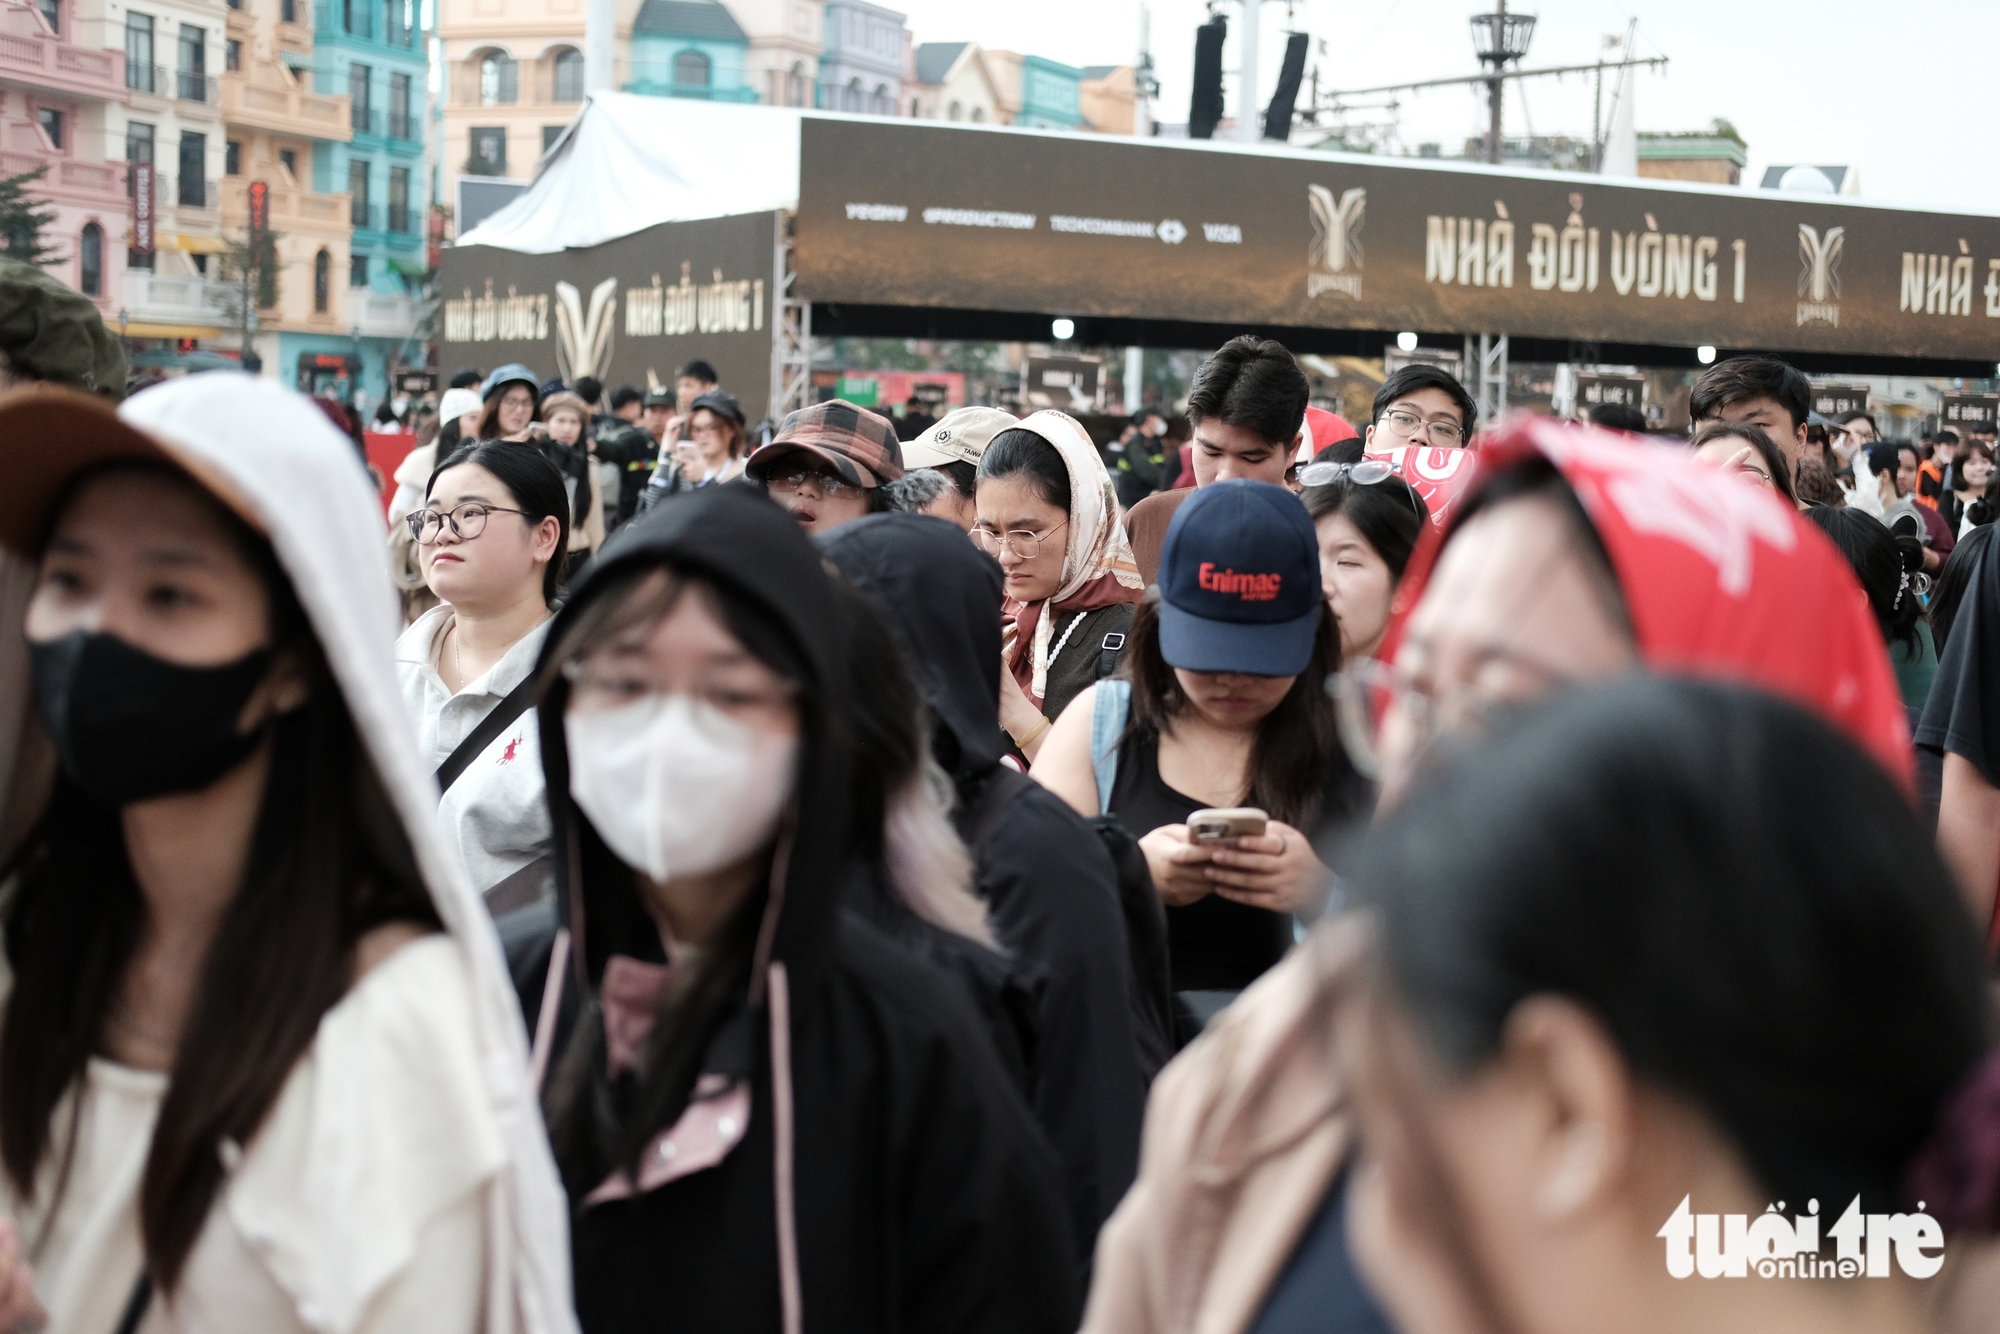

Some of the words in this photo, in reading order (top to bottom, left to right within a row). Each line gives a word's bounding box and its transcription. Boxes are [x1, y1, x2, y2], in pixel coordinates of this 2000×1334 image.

[1049, 214, 1156, 239] TECHCOMBANK
[1201, 222, 1243, 244] VISA
[1425, 199, 1515, 289] NHÀ
[1527, 192, 1600, 294] ĐỔI
[1611, 212, 1719, 302] VÒNG
[1731, 238, 1746, 304] 1
[1900, 237, 1974, 317] NHÀ
[625, 272, 663, 337] NHÀ
[698, 267, 750, 334] VÒNG
[753, 278, 764, 331] 1
[963, 447, 981, 458] TAIWA
[1198, 561, 1282, 593] Enimac
